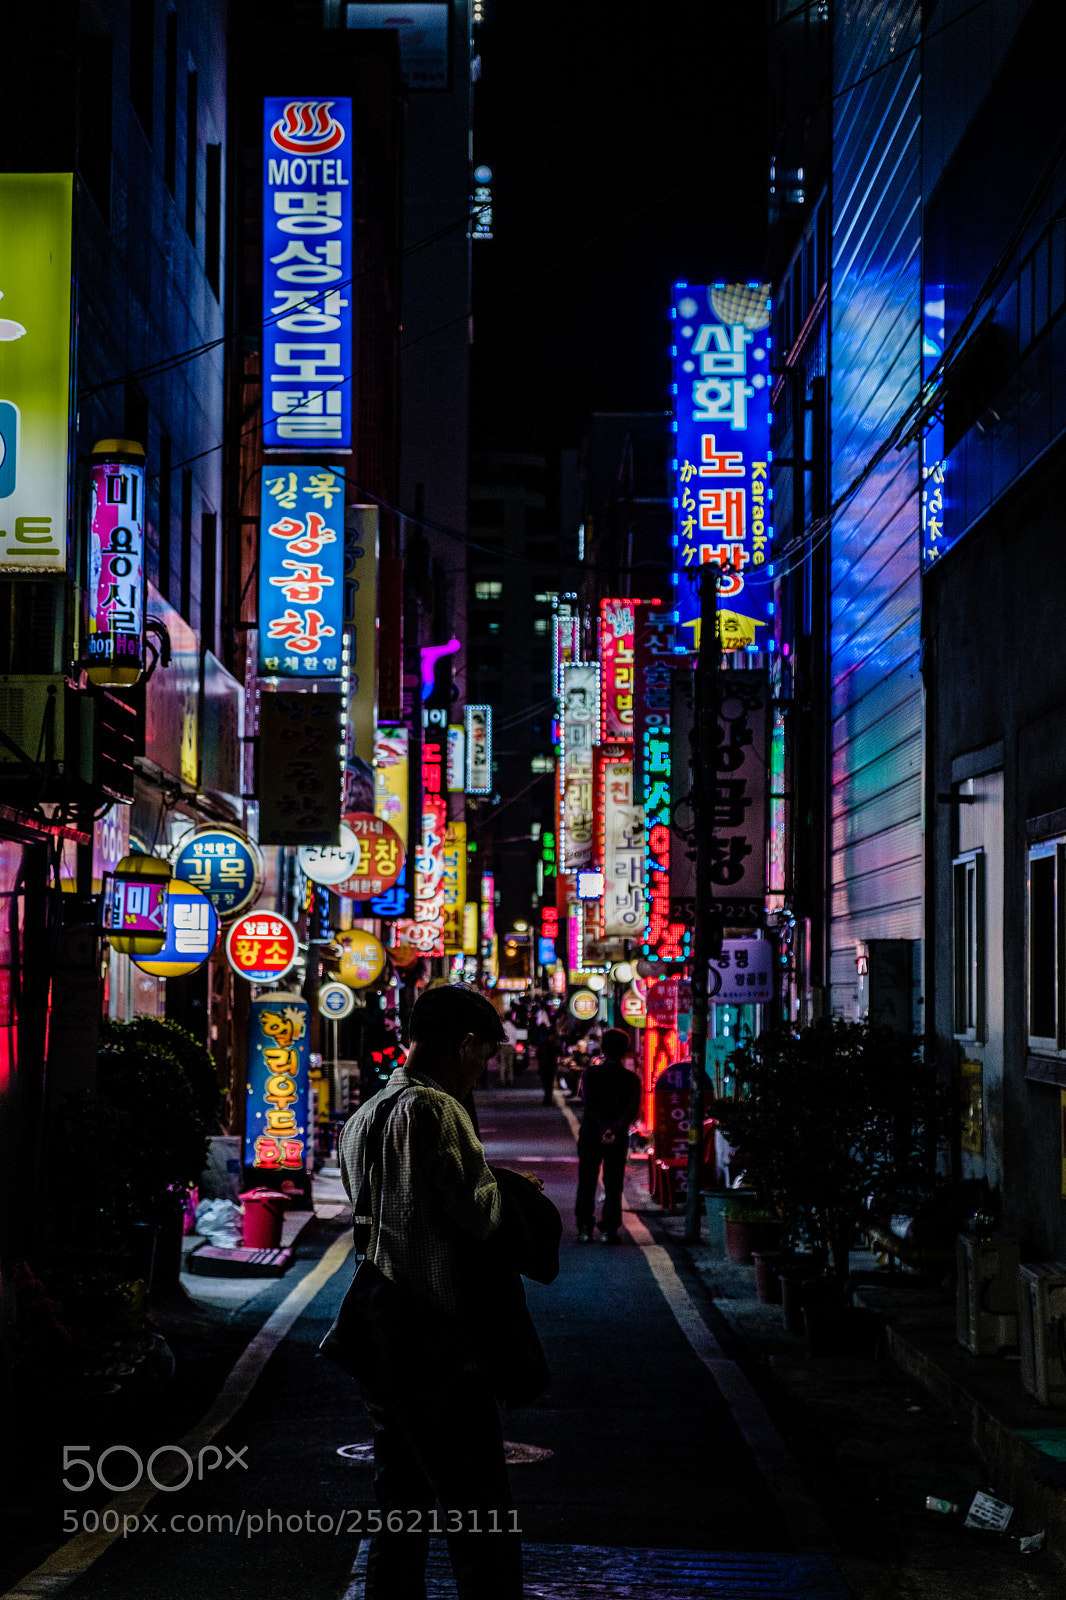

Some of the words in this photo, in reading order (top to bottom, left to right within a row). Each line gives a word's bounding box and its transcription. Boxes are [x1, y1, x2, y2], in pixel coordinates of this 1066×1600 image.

[268, 158, 349, 186] MOTEL
[691, 323, 754, 431] 삼화
[265, 472, 341, 509] 길목
[680, 460, 698, 566] からオケ
[698, 434, 749, 597] 노래방
[751, 461, 768, 565] Karaoke
[0, 516, 60, 555] 트
[101, 474, 139, 632] 미용실
[268, 512, 337, 654] 양곱창
[182, 858, 247, 889] 길목
[235, 940, 288, 966] 황소
[254, 1135, 304, 1171] 호프
